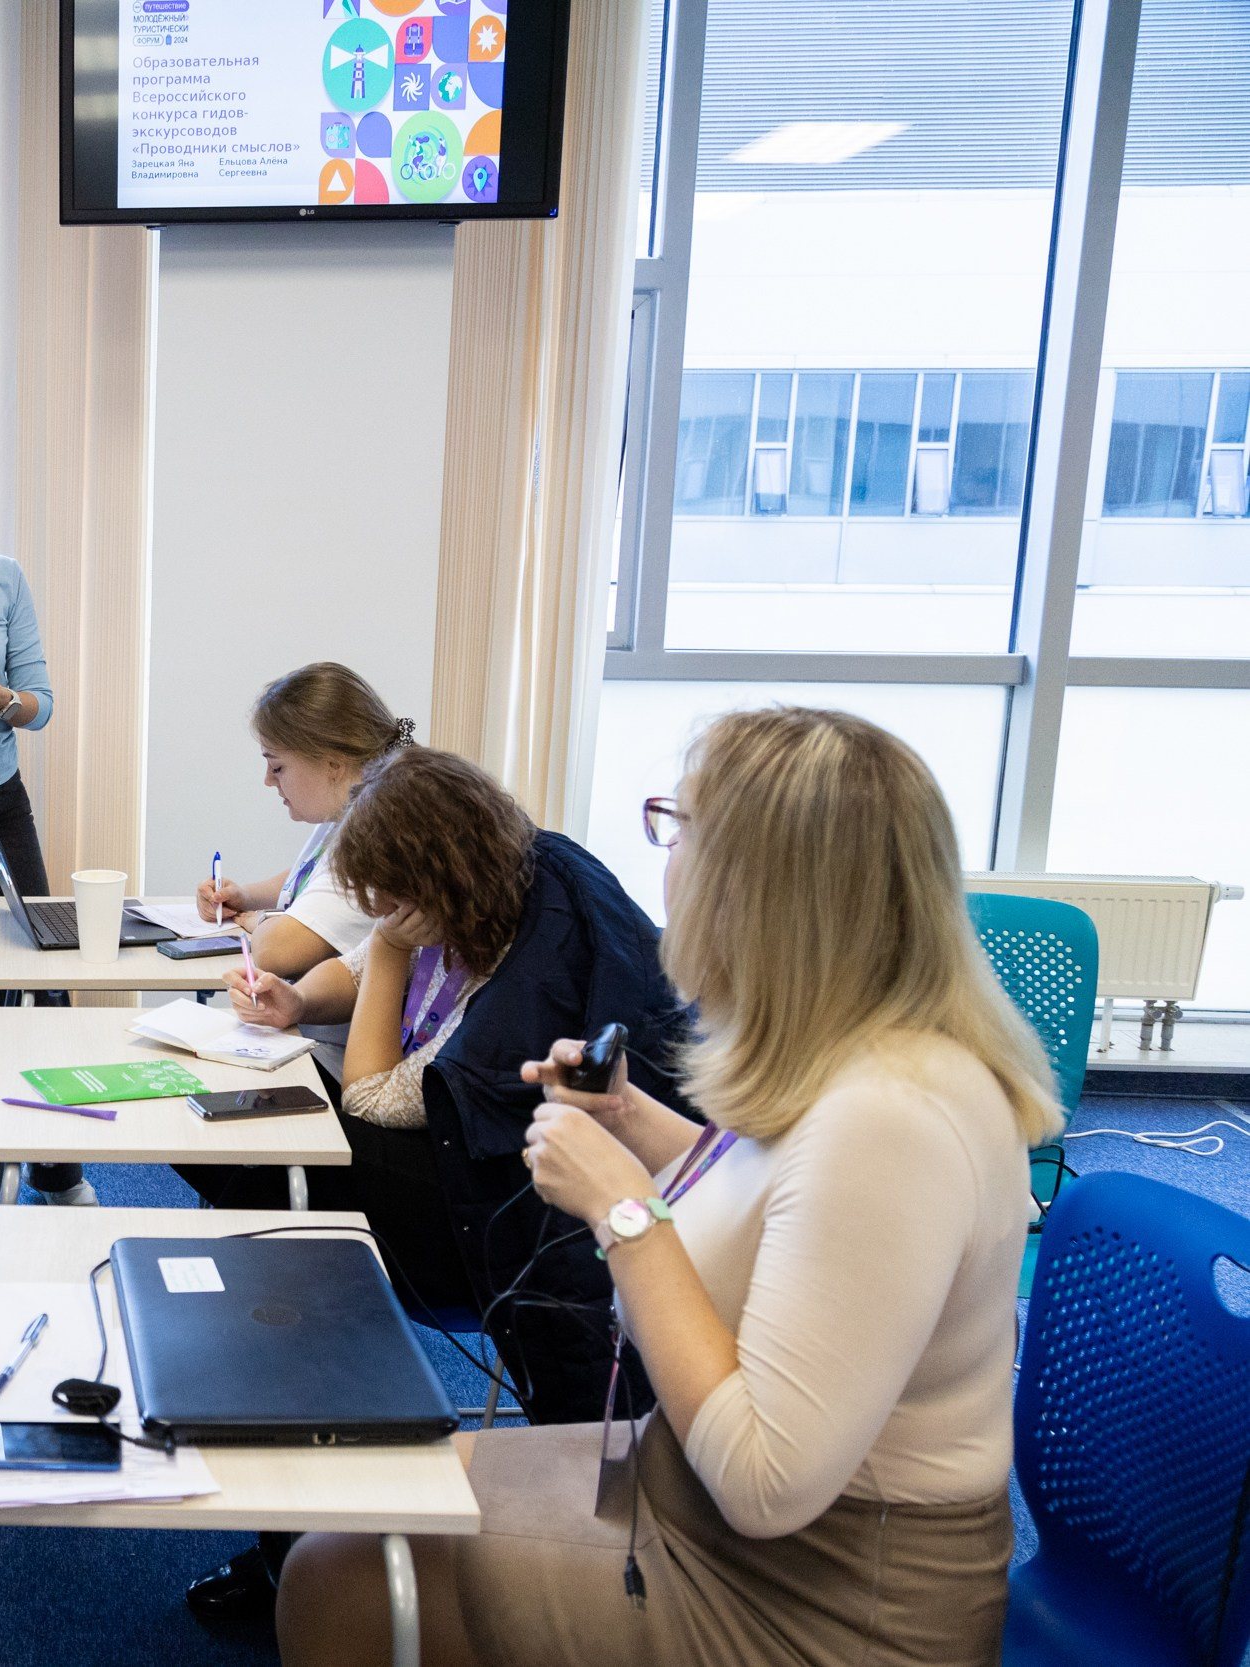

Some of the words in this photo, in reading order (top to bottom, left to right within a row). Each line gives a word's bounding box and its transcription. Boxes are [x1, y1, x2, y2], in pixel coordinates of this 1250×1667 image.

[173, 36, 188, 44] 2024
[132, 56, 259, 70] Образовательная
[132, 75, 211, 88] программа
[132, 90, 246, 105] Всероссийского
[132, 110, 198, 122] конкурса
[202, 108, 249, 121] гидов-
[132, 127, 238, 139] экскурсоводов
[132, 143, 227, 157] «Проводники
[231, 142, 301, 153] смыслов»
[131, 159, 175, 169] Зарецкая
[177, 158, 195, 168] Яна
[219, 157, 257, 167] Ельцова
[259, 156, 288, 166] Алёна
[131, 170, 199, 180] Владимировна
[218, 168, 268, 178] Сергеевна
